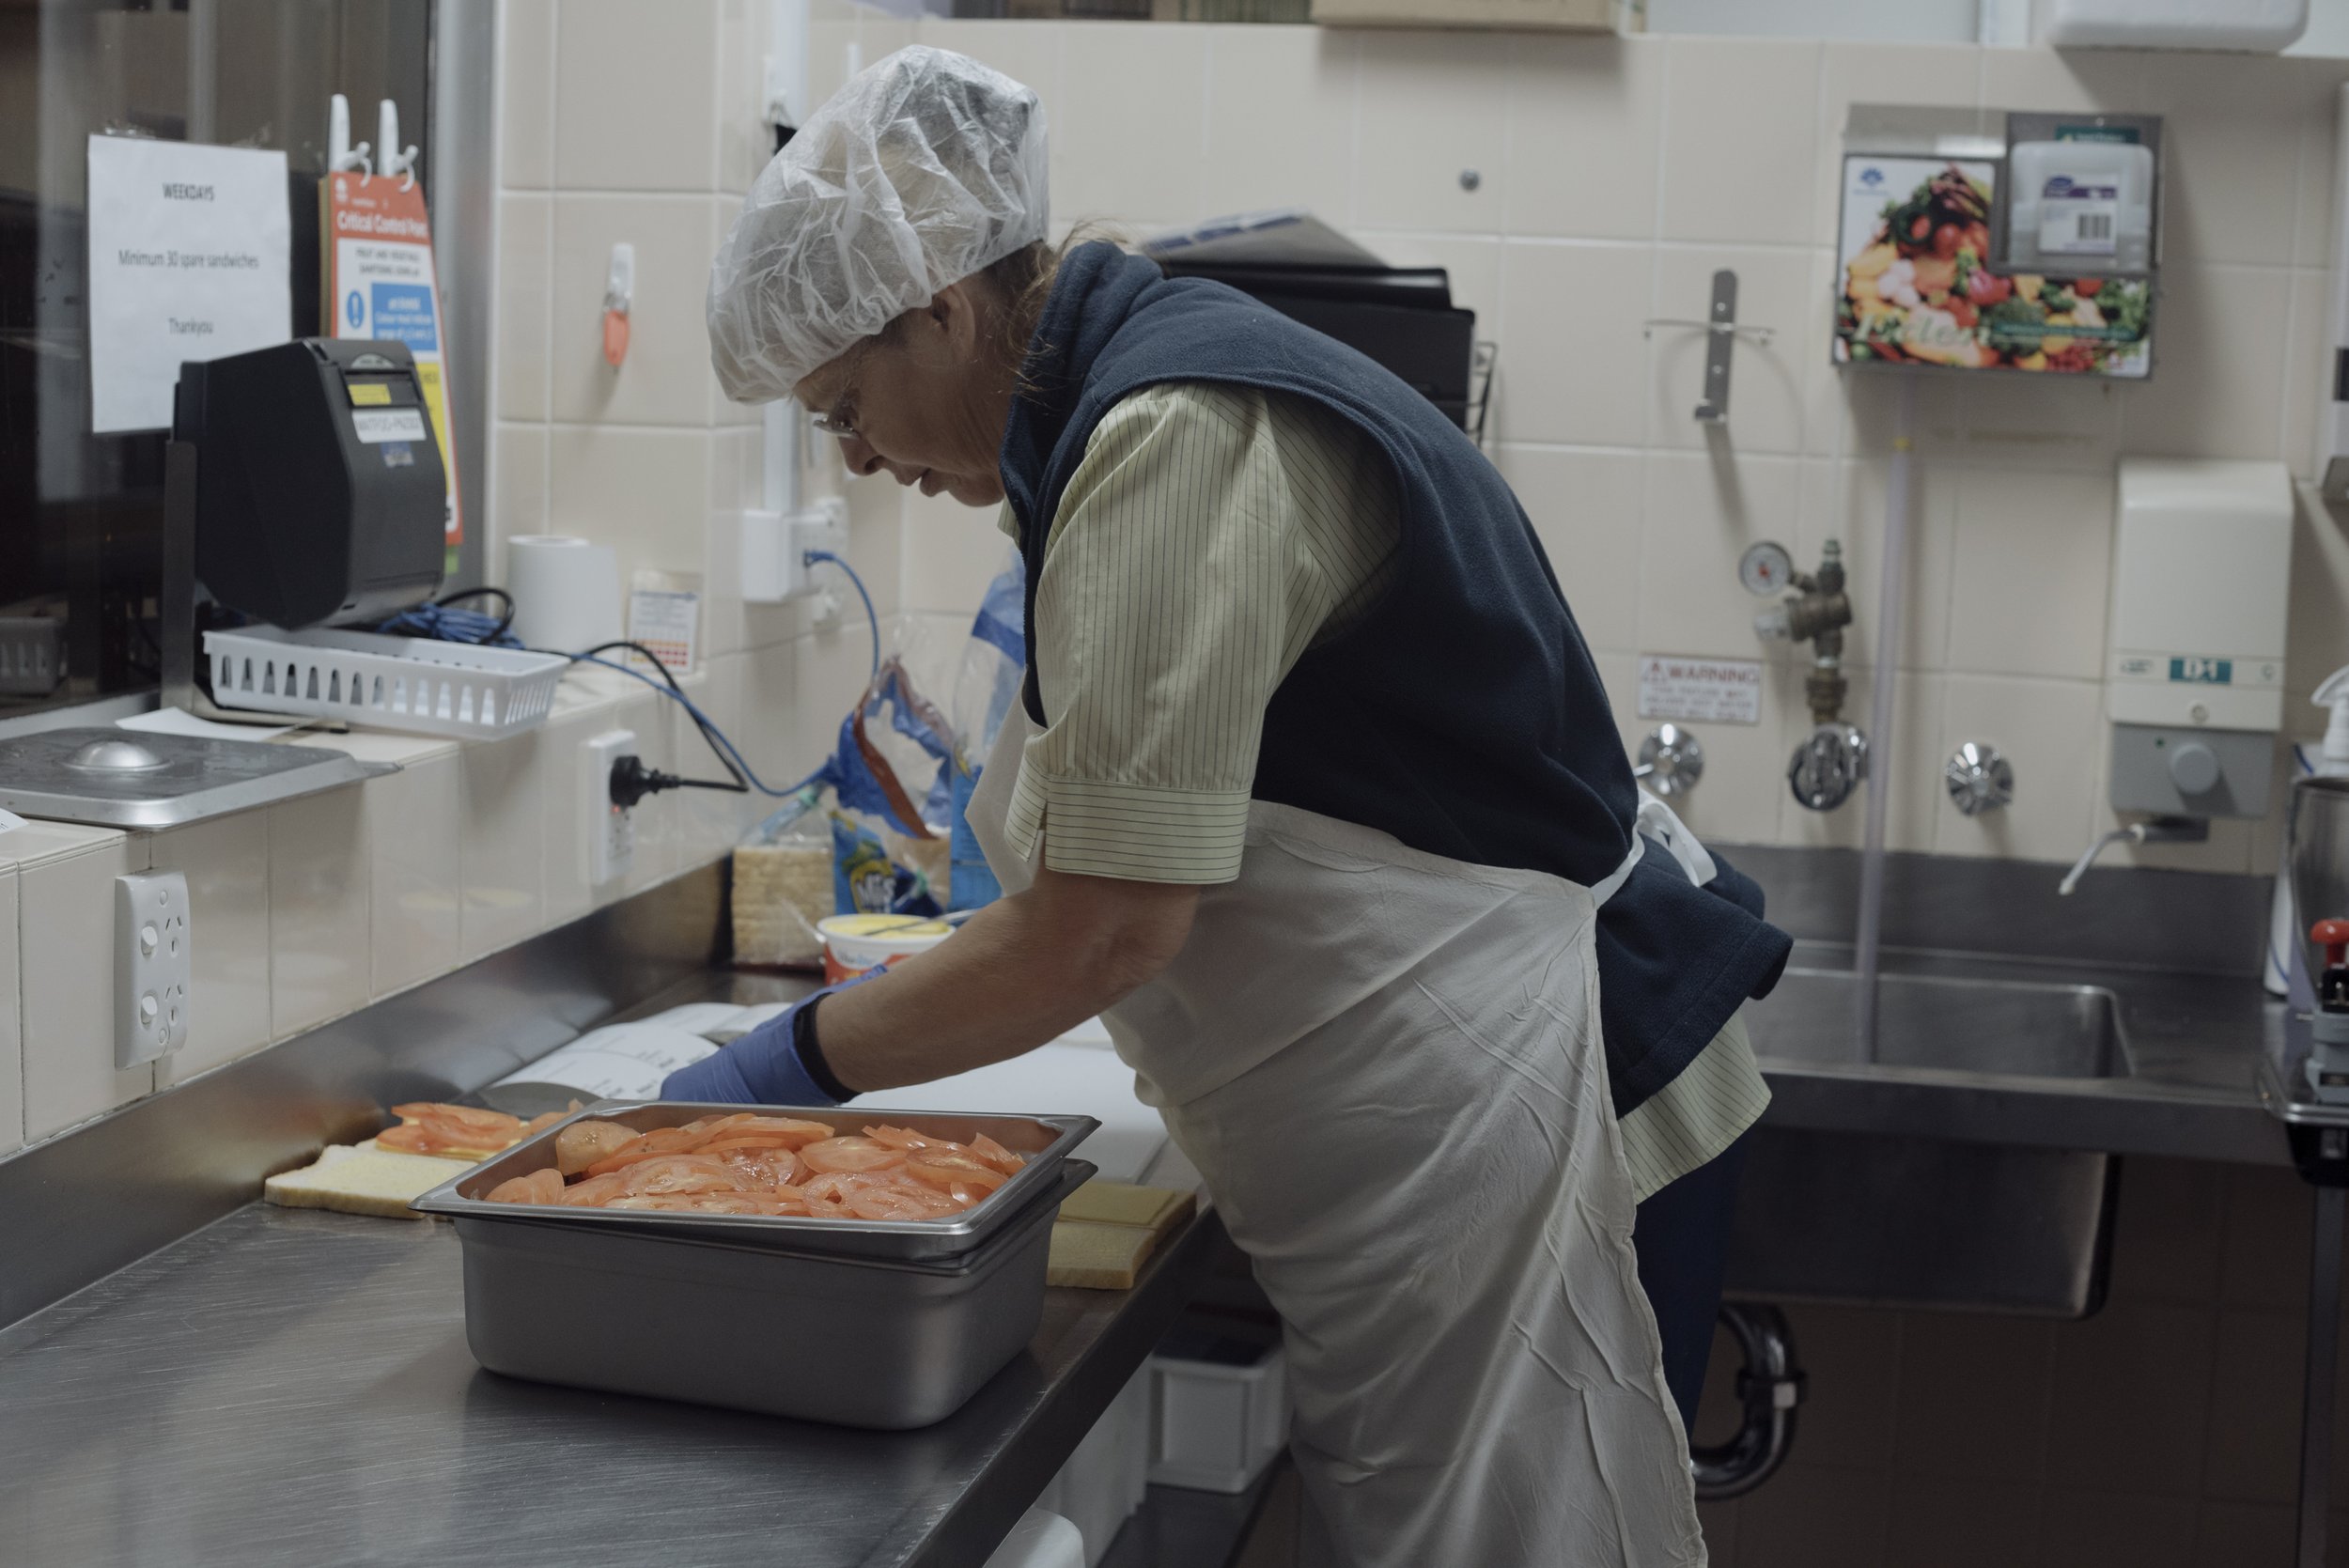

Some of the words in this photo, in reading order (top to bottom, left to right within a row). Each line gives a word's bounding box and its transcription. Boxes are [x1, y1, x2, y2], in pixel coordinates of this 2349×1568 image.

[162, 182, 215, 202] WEEKDAYS
[336, 210, 372, 233] Critical
[374, 213, 408, 237] Control
[118, 248, 164, 266] Minimum
[166, 250, 179, 268] 30
[180, 255, 204, 270] spare
[207, 252, 260, 271] sandwiches
[168, 317, 213, 338] Thankyou
[1669, 664, 1760, 684] WARNING
